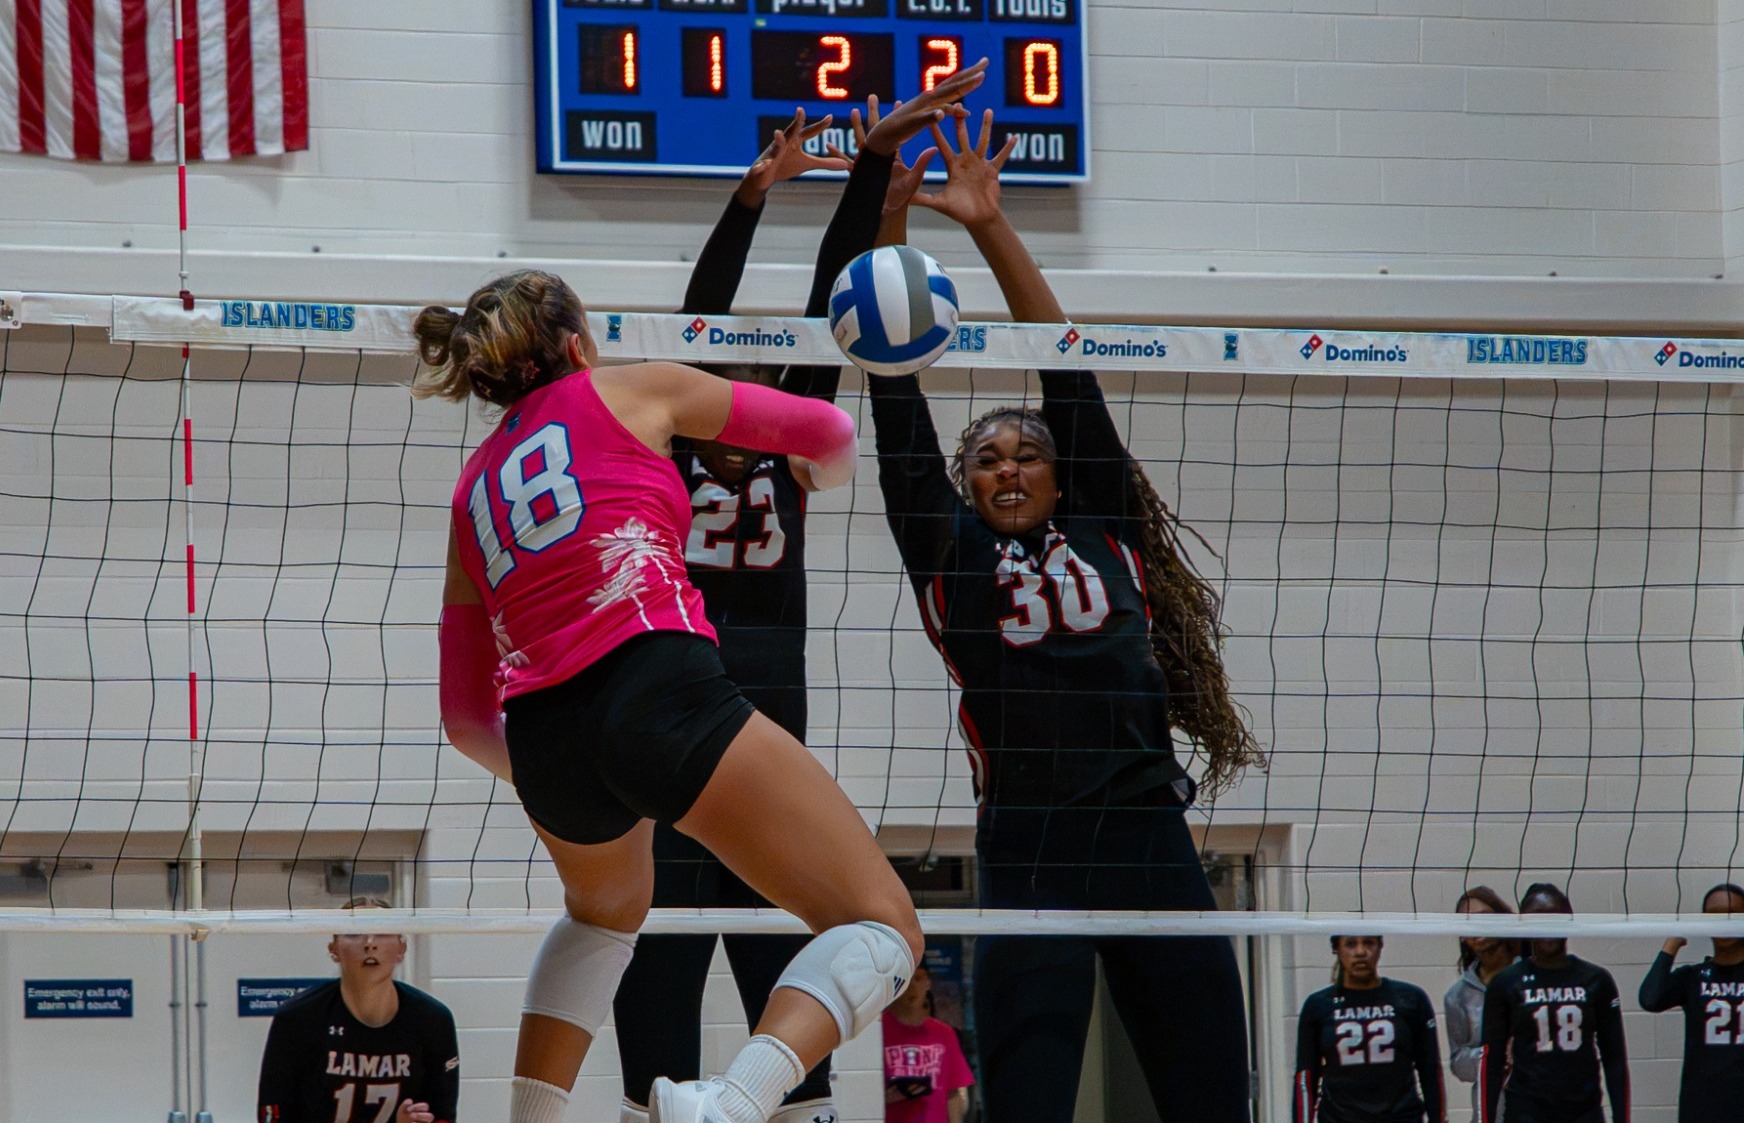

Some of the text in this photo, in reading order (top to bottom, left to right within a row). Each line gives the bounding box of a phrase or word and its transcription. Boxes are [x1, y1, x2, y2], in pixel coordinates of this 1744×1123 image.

[623, 31, 636, 89] 1
[710, 35, 722, 92] 1
[817, 35, 851, 98] 2
[1023, 42, 1060, 105] 0
[582, 119, 643, 150] won
[1006, 132, 1065, 161] won
[220, 300, 355, 331] ISLANDERS
[708, 327, 797, 347] Domino's
[1082, 338, 1167, 358] Domino's
[1466, 336, 1588, 365] ISLANDERS
[1325, 343, 1408, 363] Domino's
[468, 421, 587, 593] 18
[683, 475, 787, 571] 23
[995, 542, 1111, 649] 30
[1524, 986, 1587, 1004] LAMAR
[1333, 1004, 1396, 1020] LAMAR
[1335, 1020, 1396, 1067] 22
[1532, 1004, 1583, 1052] 18
[325, 1050, 412, 1078] LAMAR
